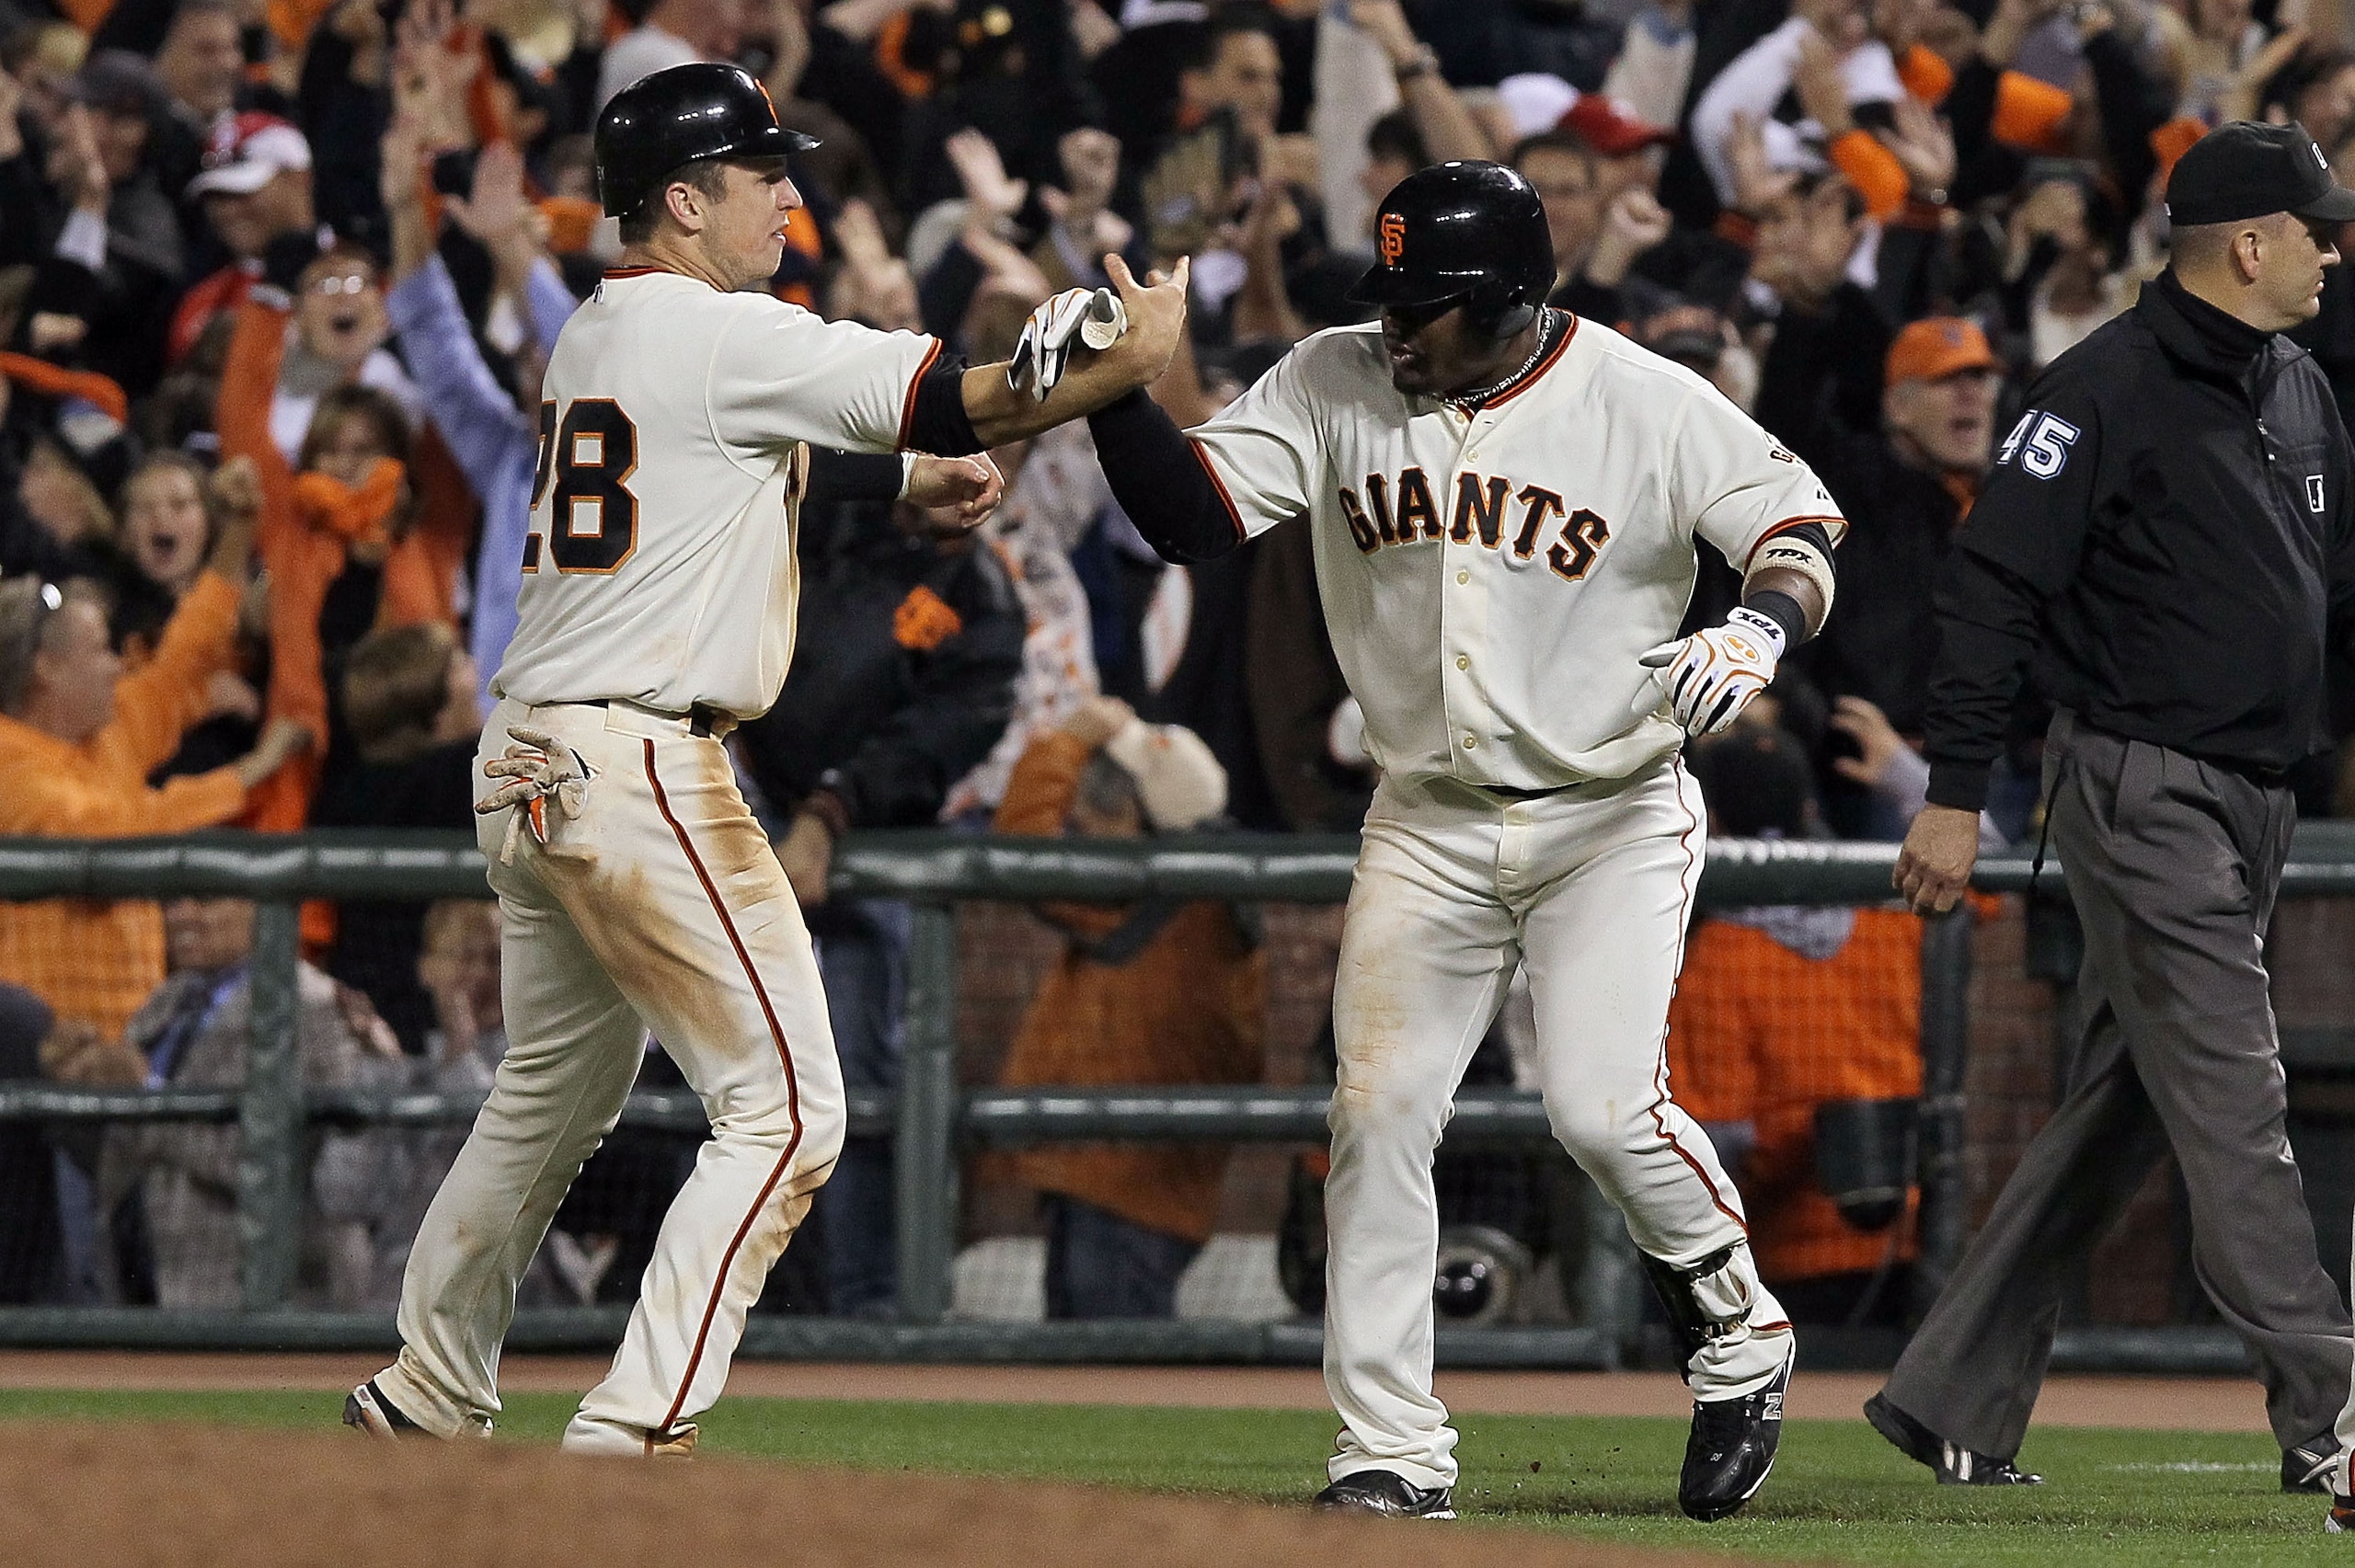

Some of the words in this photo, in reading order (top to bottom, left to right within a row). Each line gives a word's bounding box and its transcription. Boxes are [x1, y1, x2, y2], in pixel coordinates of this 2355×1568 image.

[1381, 213, 1406, 266] SF
[1997, 409, 2081, 480] 45
[1338, 466, 1611, 582] GIANTS
